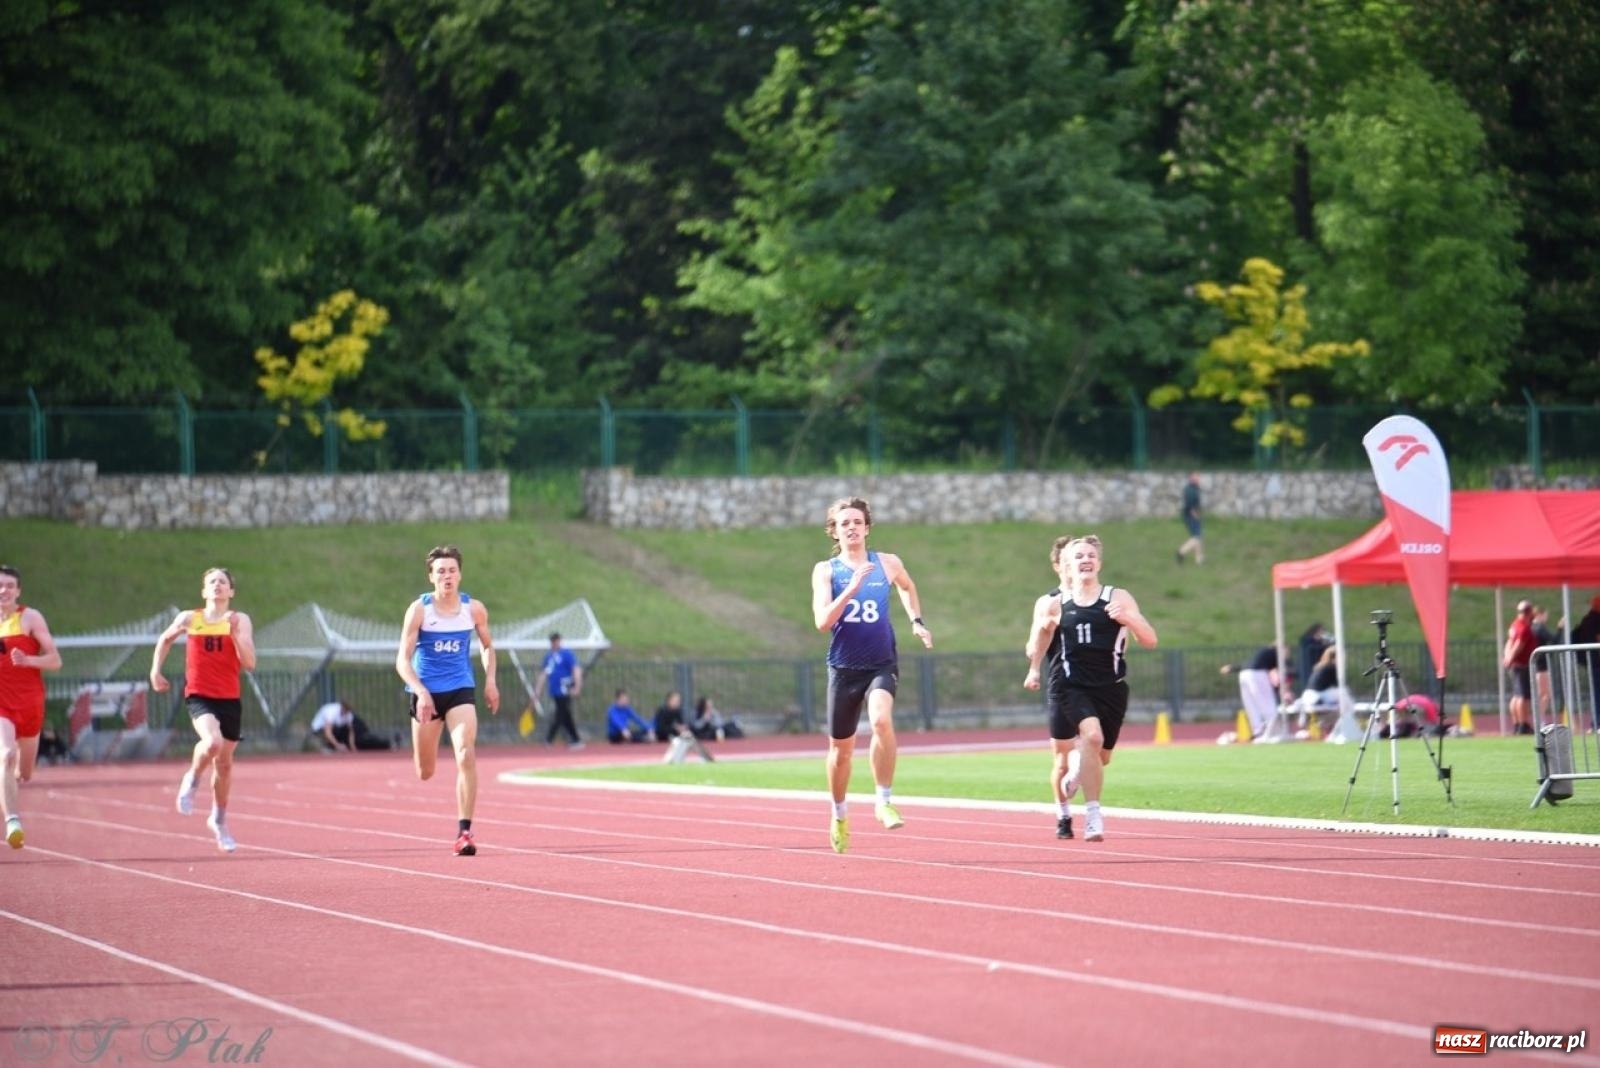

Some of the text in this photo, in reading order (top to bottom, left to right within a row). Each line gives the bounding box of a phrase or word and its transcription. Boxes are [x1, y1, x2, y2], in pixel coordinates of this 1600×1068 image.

[844, 598, 880, 623] 28
[1075, 622, 1092, 644] 11
[204, 636, 223, 653] 81
[434, 640, 460, 653] 945
